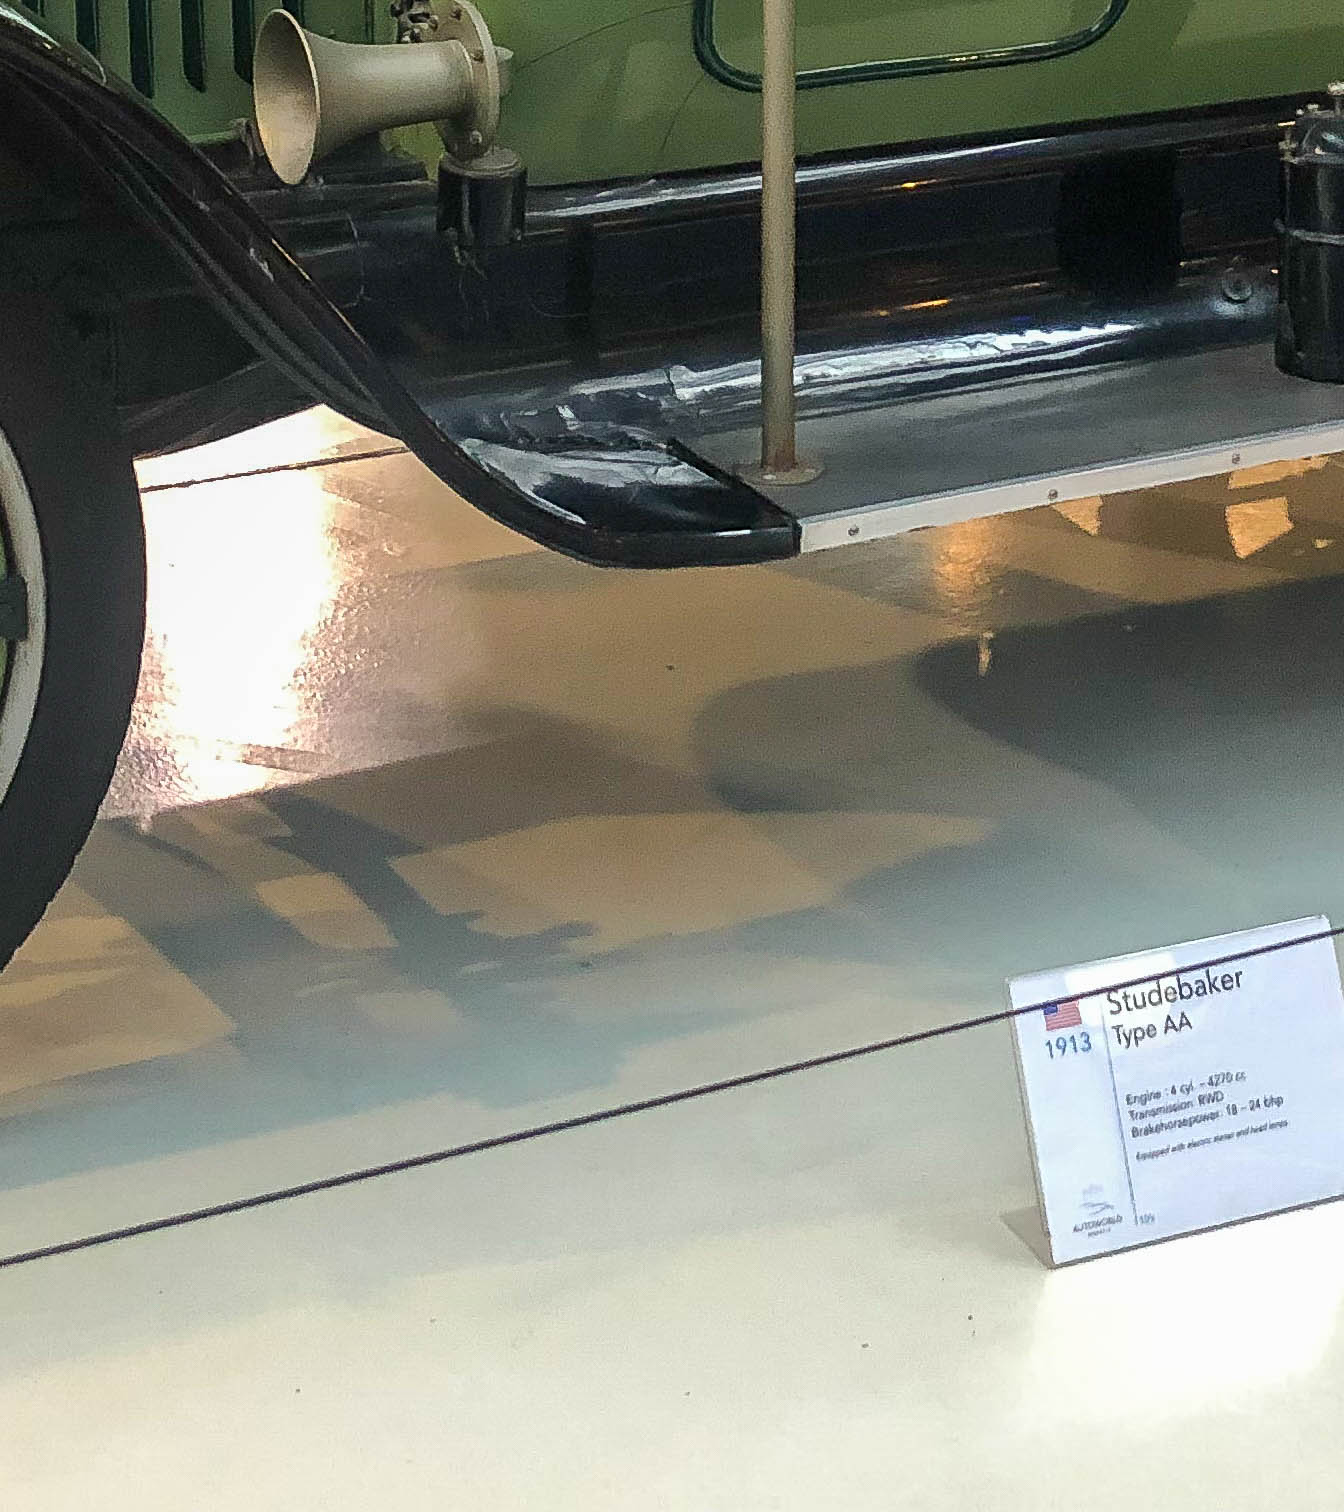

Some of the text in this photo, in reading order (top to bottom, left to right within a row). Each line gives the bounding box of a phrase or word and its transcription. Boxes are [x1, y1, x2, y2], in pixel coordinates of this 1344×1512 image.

[1107, 969, 1243, 1016] Studebaker
[1112, 1011, 1193, 1050] Type AA
[1045, 1031, 1092, 1059] 1913
[1126, 1090, 1162, 1106] Engine
[1170, 1085, 1177, 1096] 4
[1198, 1090, 1225, 1106] RWD
[1249, 1099, 1261, 1112] 24
[1263, 1093, 1284, 1108] bhp
[1073, 1214, 1123, 1233] AUTOWORLD
